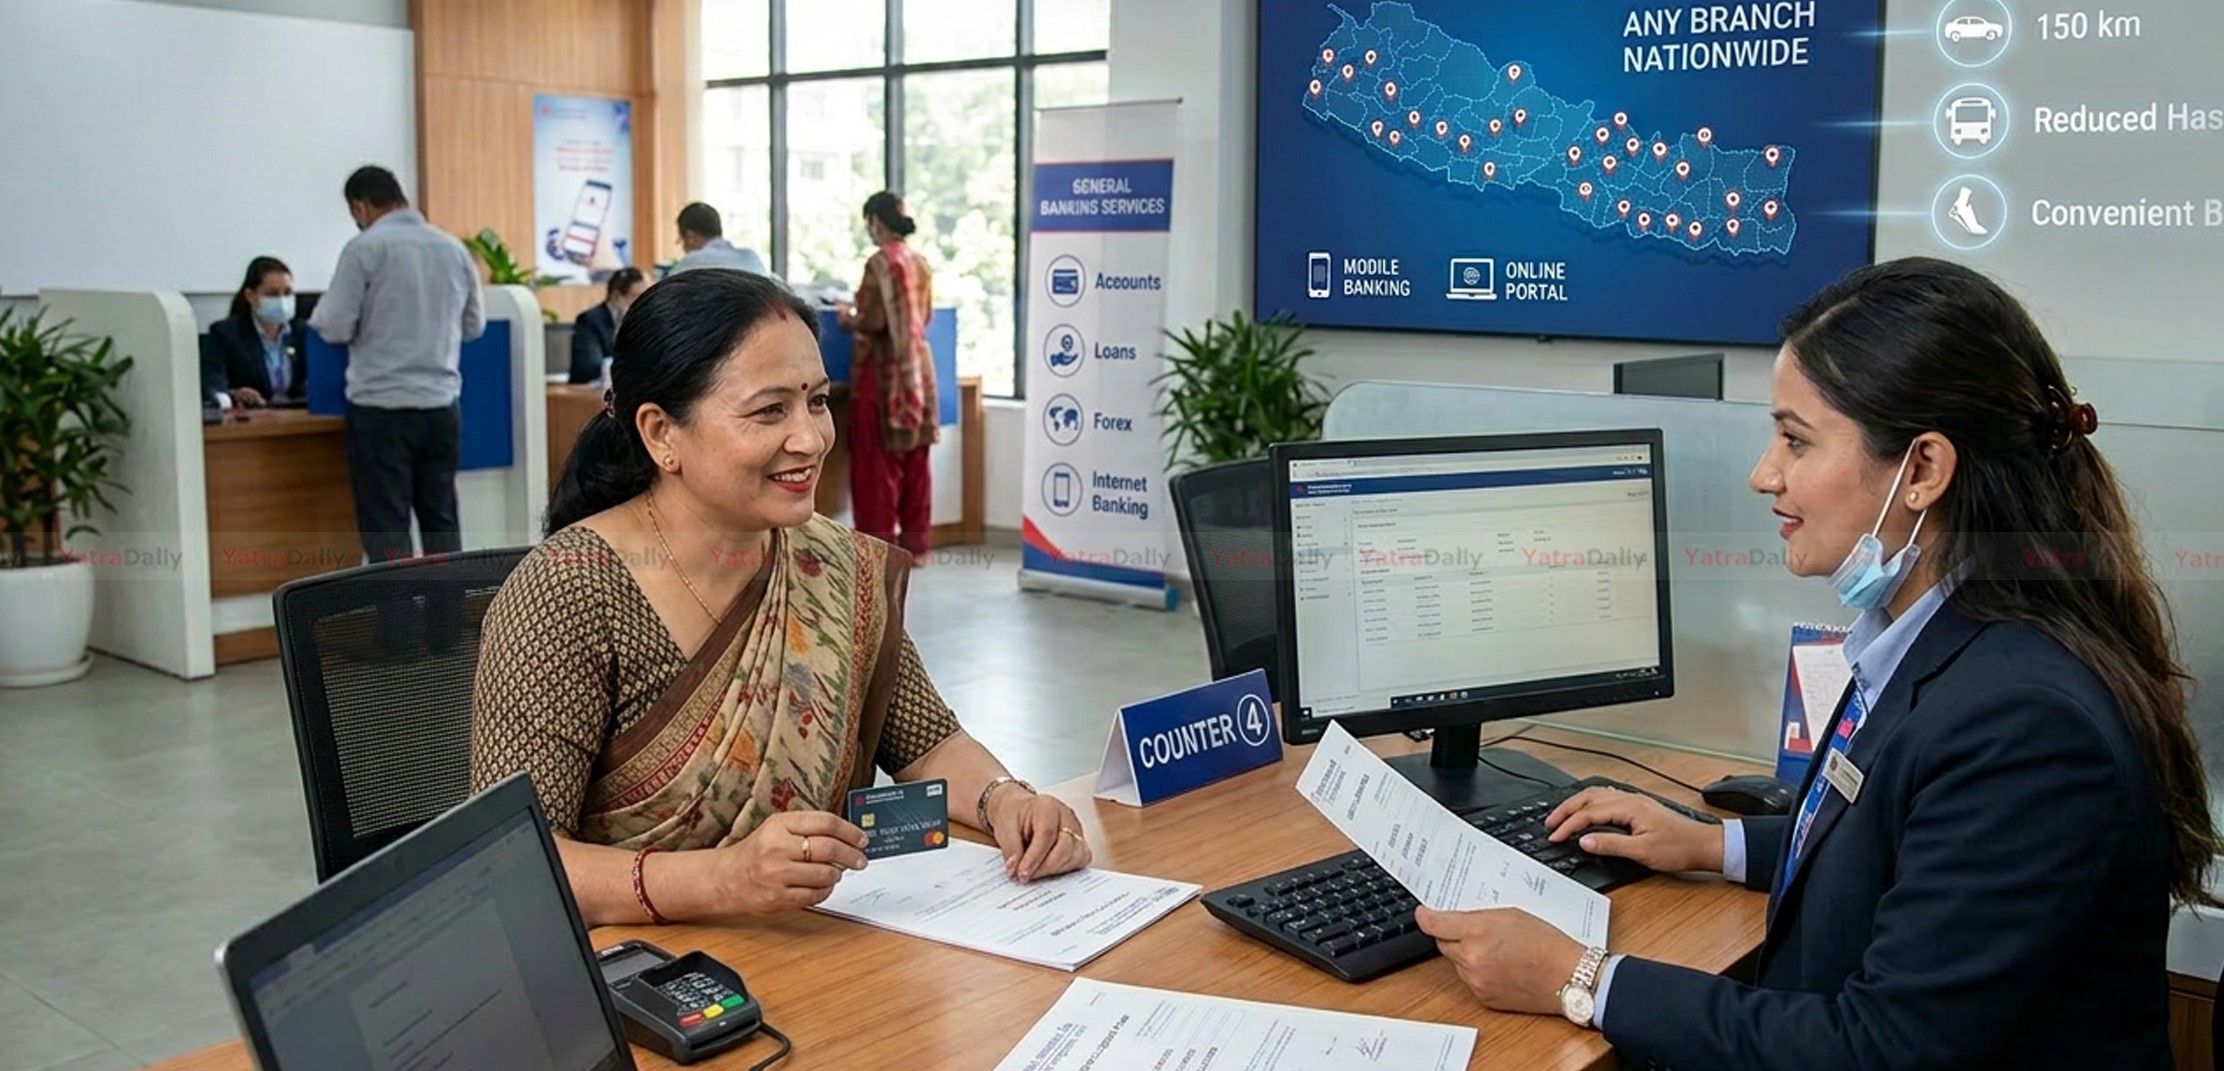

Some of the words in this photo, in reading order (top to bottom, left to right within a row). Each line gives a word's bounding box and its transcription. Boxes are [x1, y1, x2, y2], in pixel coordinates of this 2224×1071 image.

[1623, 8, 1682, 37] ANY
[1690, 1, 1815, 34] BRANCH
[2038, 12, 2088, 40] 150
[2098, 10, 2141, 38] km
[1624, 37, 1809, 72] NATIONWIDE
[2034, 103, 2157, 133] Reduced
[2167, 102, 2224, 131] Has
[1101, 197, 1165, 215] SERVICES
[2031, 199, 2194, 227] Convenient
[1505, 262, 1566, 280] ONLINE
[1343, 280, 1411, 296] BANKING
[1505, 283, 1568, 301] PORTAL
[1094, 341, 1137, 360] Loans
[1094, 412, 1132, 431] Forex
[1092, 470, 1148, 493] Internet
[1092, 494, 1149, 520] Banking
[1139, 714, 1237, 769] COUNTER
[1246, 701, 1263, 736] 4
